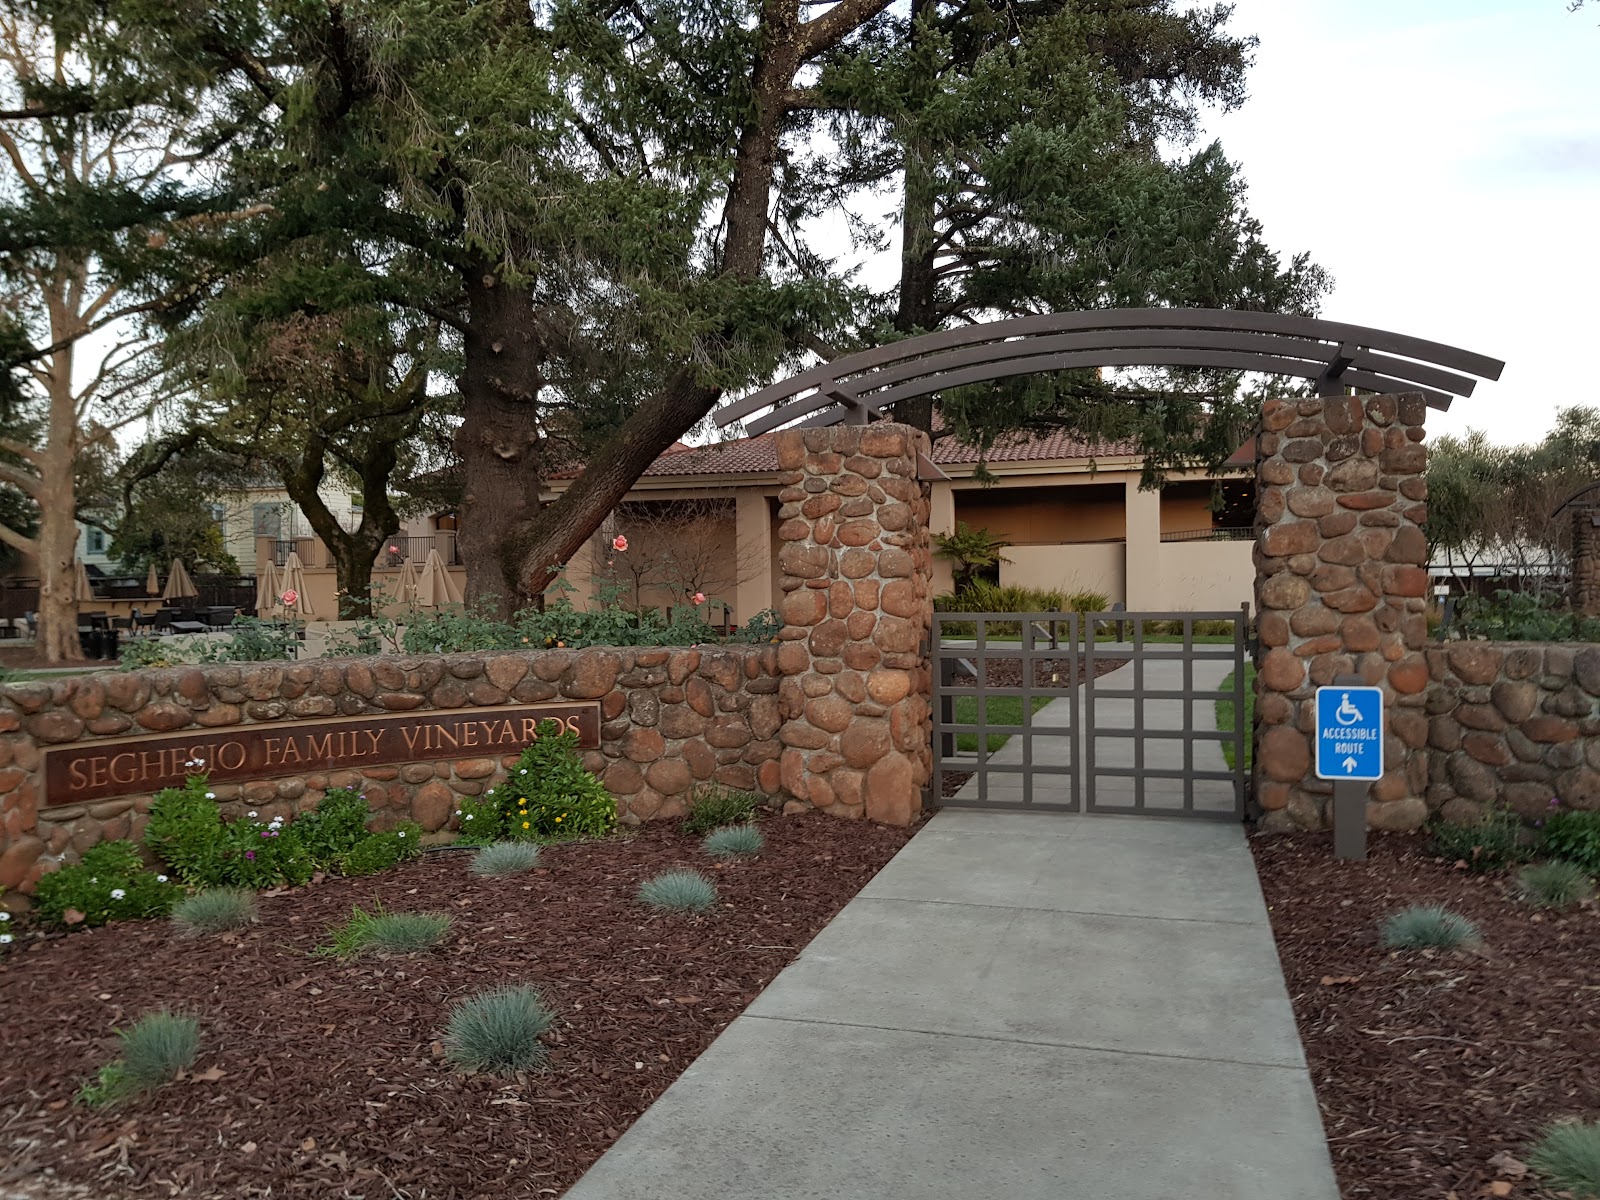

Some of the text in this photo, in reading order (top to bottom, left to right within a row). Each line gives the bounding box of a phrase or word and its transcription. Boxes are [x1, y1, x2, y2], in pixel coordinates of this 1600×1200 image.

[1322, 727, 1377, 740] ACCESSIBLE
[1334, 742, 1364, 754] ROUTE
[69, 741, 246, 790] SEGHESIO
[264, 728, 386, 765] FAMILY
